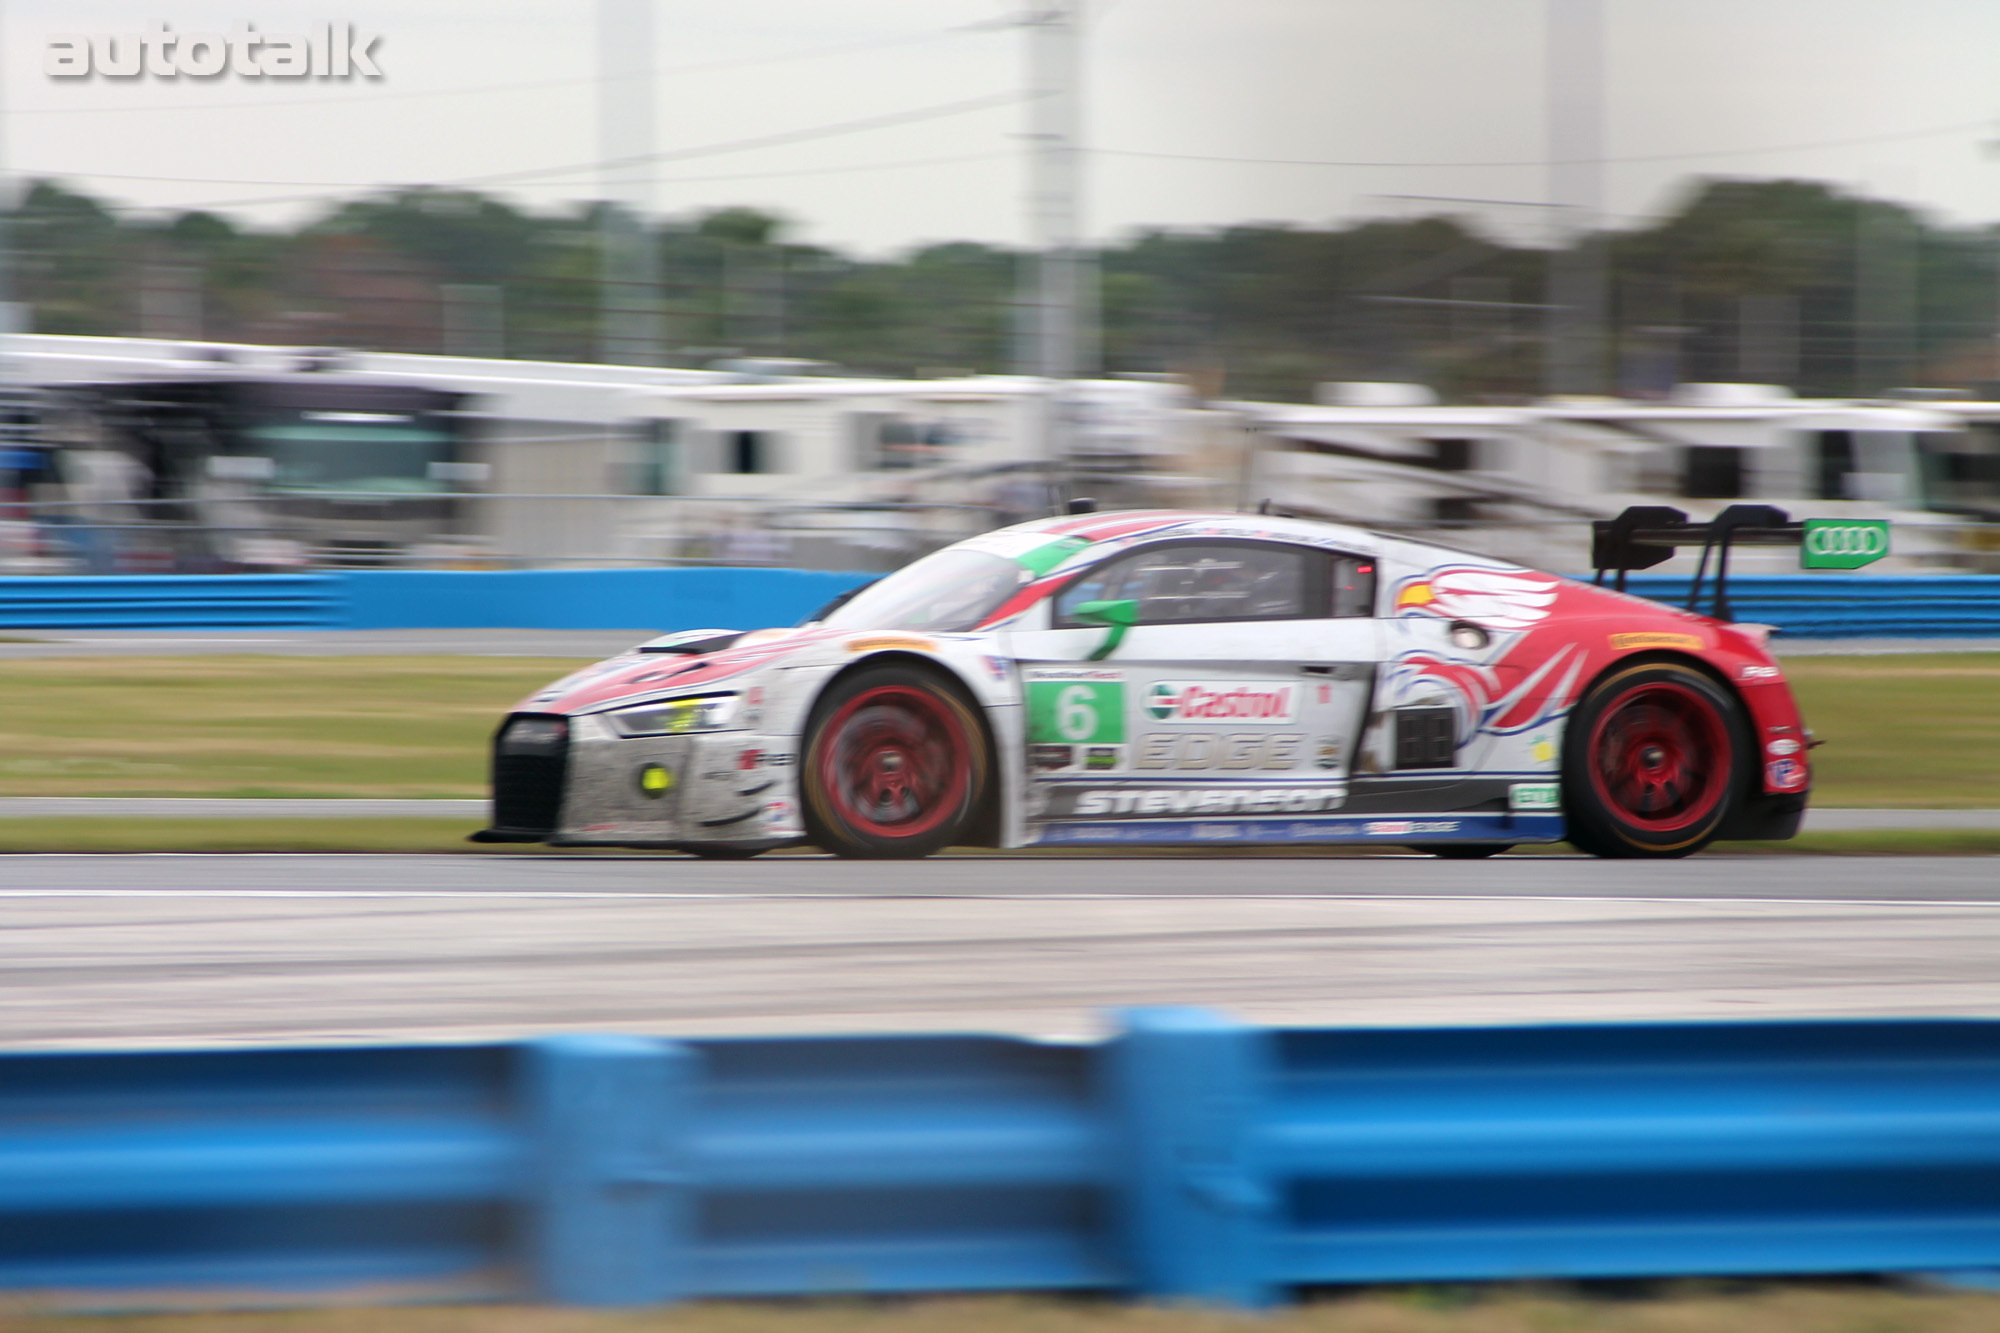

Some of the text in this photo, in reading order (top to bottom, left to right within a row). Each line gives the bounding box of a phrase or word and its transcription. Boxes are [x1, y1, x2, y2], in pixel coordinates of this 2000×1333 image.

[1055, 684, 1099, 741] 6
[1180, 686, 1292, 718] Castrol
[1136, 732, 1309, 770] EDGE
